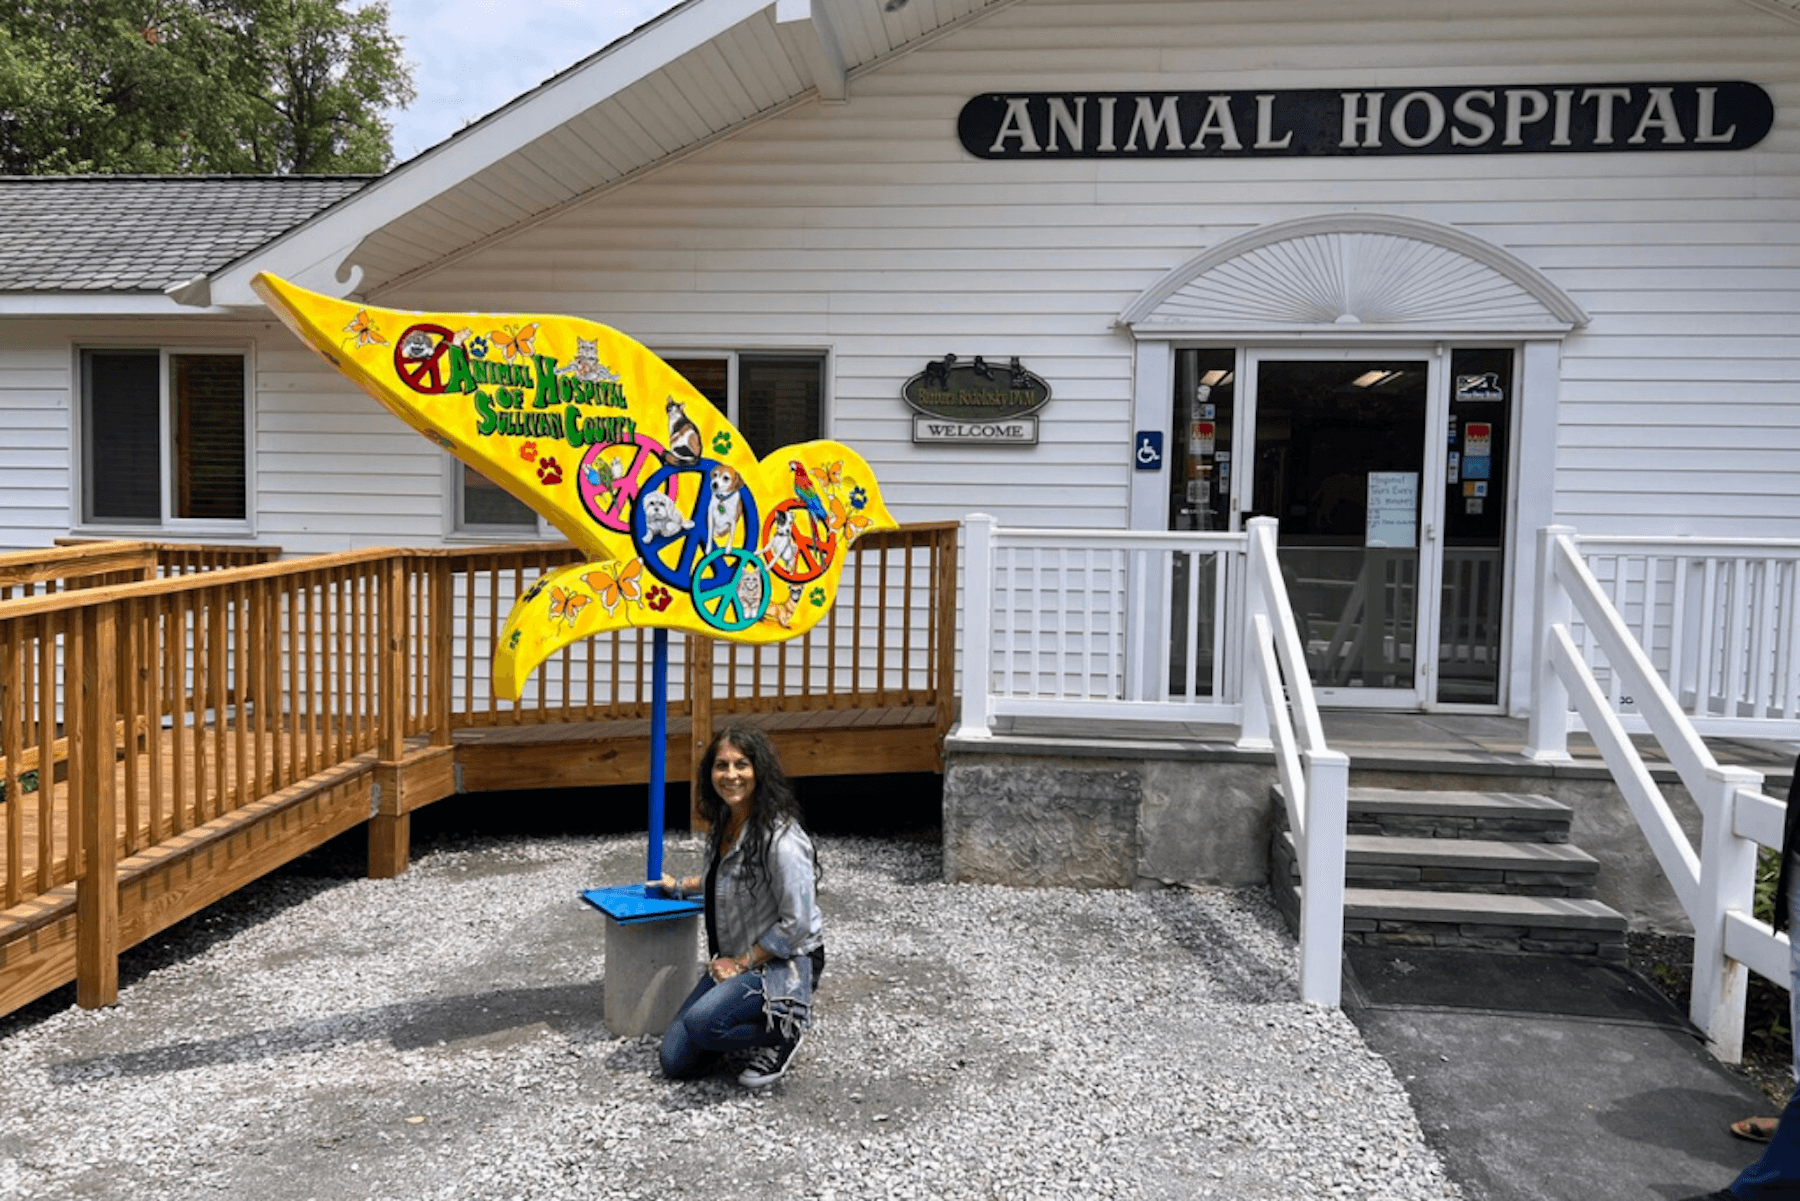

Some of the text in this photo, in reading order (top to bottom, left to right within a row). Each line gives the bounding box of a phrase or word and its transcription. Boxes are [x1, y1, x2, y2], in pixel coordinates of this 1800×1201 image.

[989, 85, 1738, 153] ANIMAL HOSPITAL
[444, 345, 628, 409] ANIMAL HOSPITAL
[495, 386, 524, 409] OF
[474, 390, 637, 448] SULLIVAN COUNTY
[928, 424, 1023, 438] WELCOME
